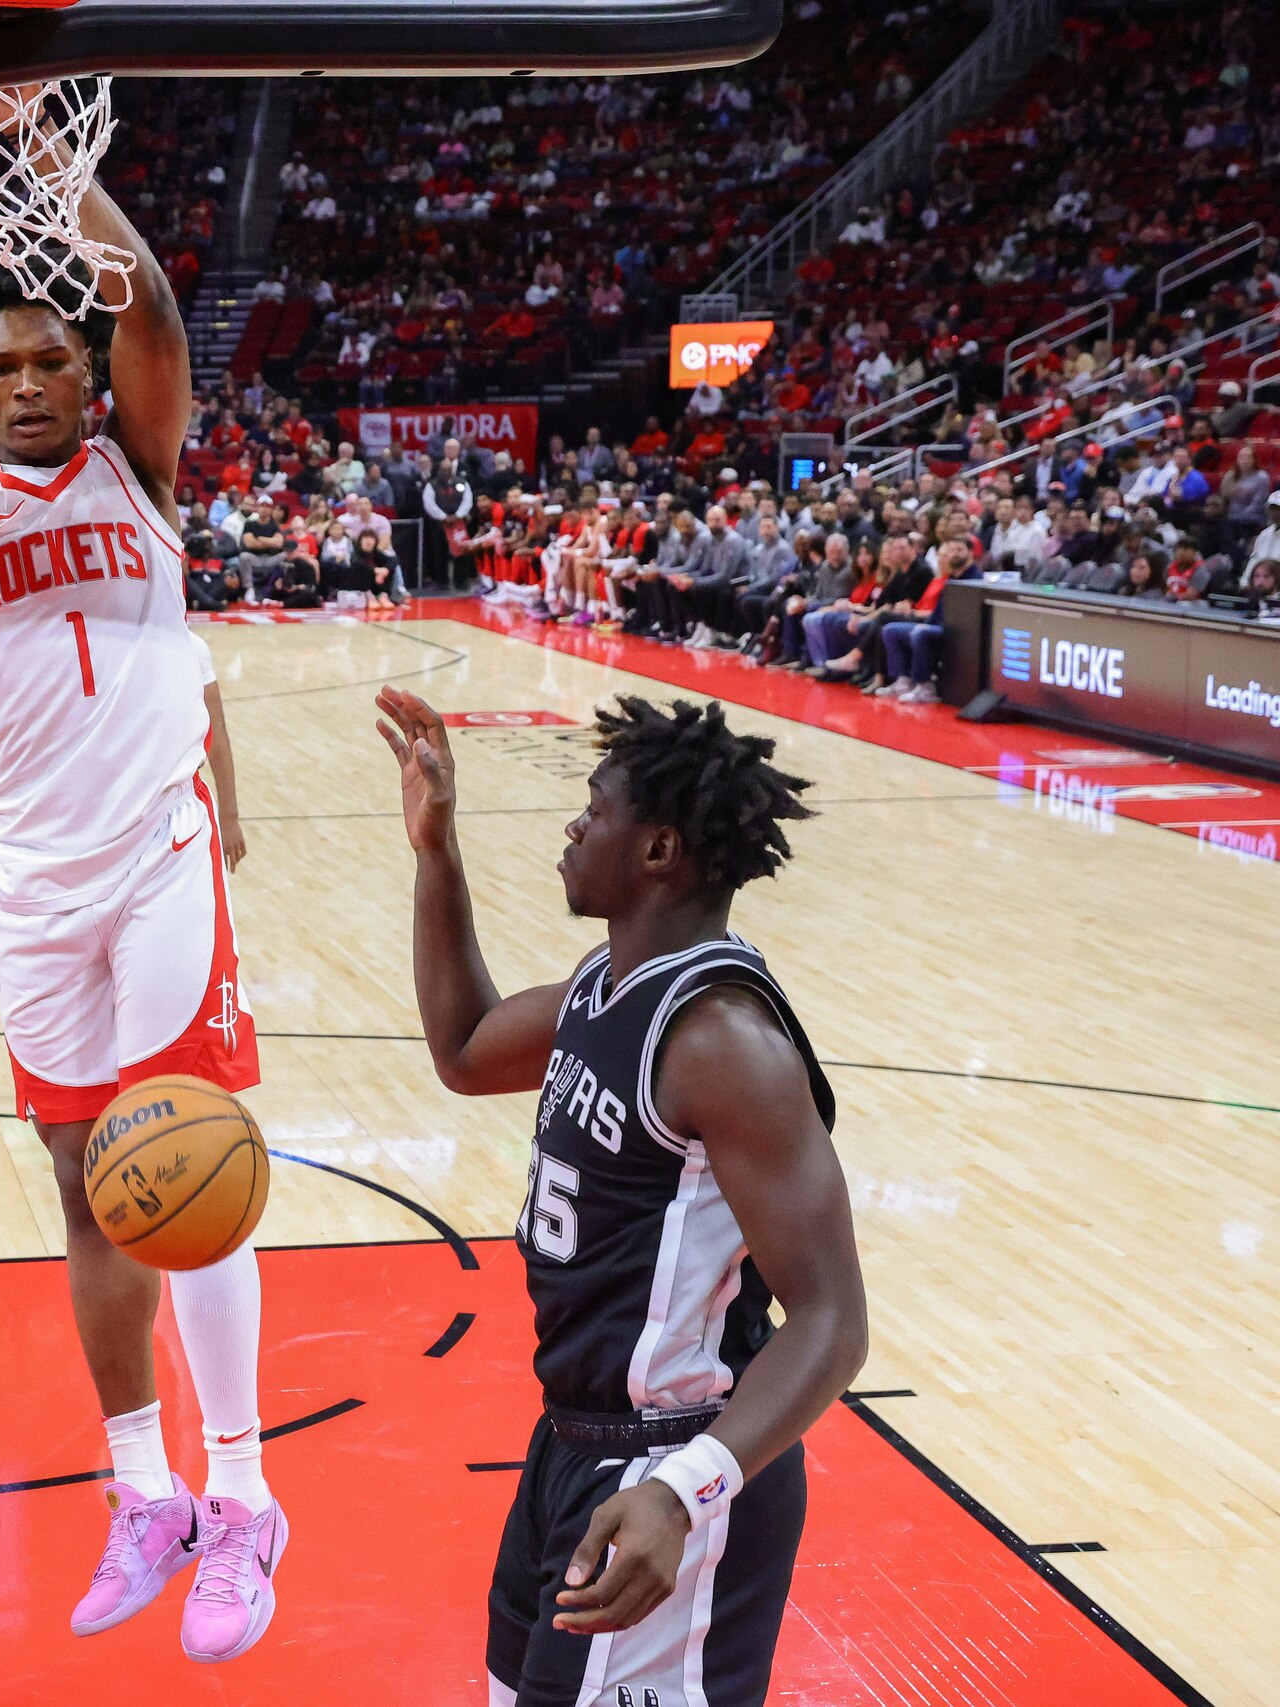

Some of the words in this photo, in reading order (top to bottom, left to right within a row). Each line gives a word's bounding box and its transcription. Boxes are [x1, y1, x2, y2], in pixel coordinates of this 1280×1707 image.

[709, 343, 761, 366] PNC
[65, 611, 96, 697] 1
[1039, 637, 1124, 698] LOCKE
[1205, 674, 1280, 728] Leading
[540, 1049, 627, 1155] PURS
